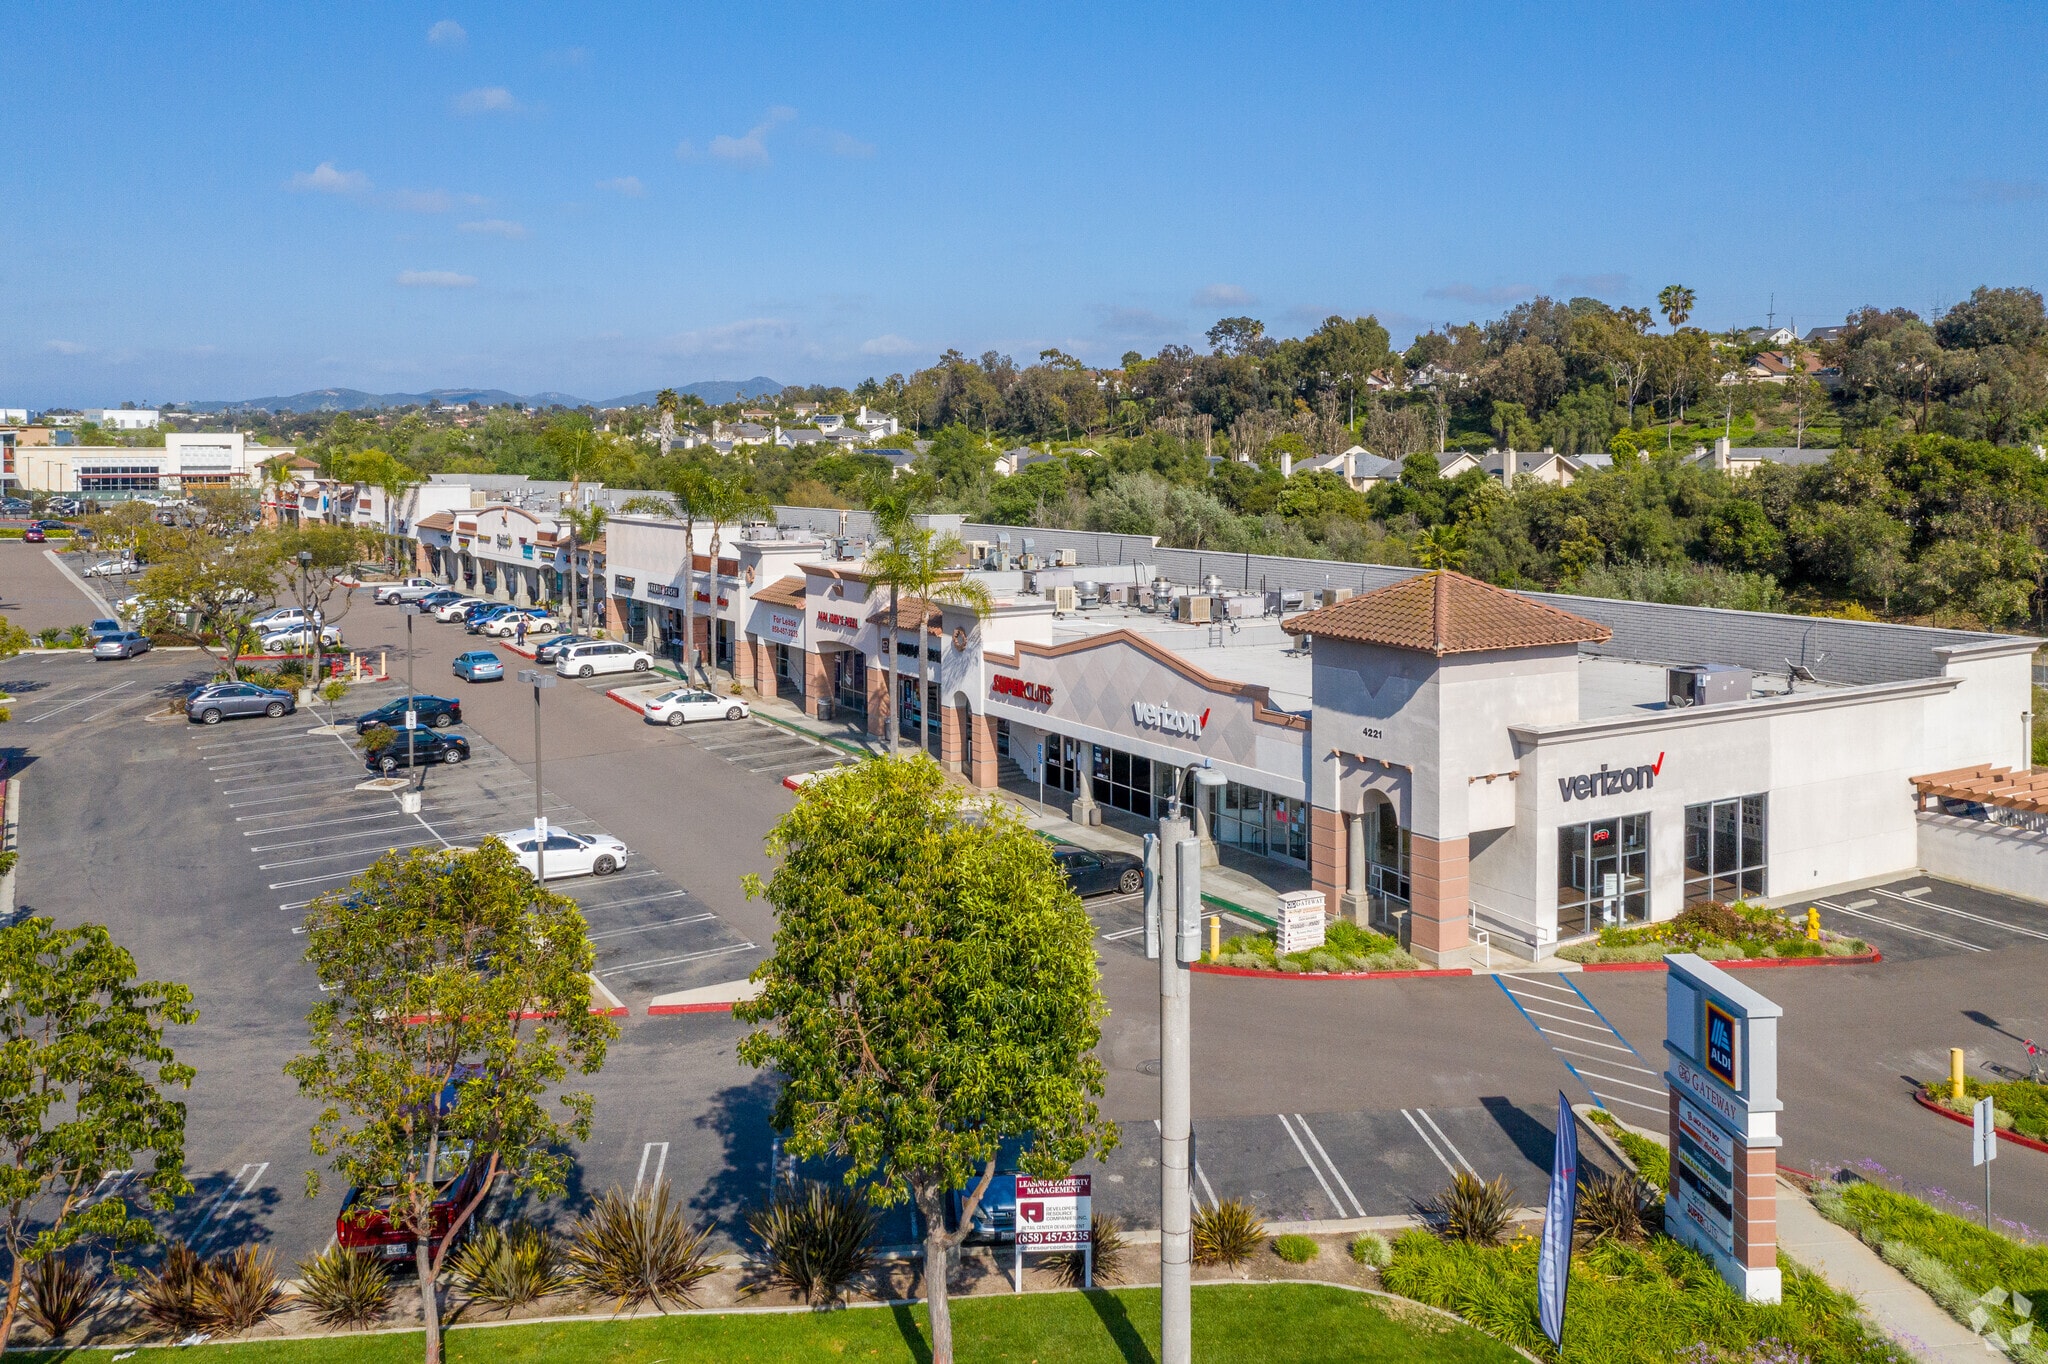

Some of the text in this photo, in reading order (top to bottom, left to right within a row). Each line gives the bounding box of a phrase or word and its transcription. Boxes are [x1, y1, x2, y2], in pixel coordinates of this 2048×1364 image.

[773, 614, 797, 627] For Lease
[992, 674, 1052, 705] SUPERCUTS
[1133, 700, 1202, 737] verizon
[1362, 727, 1382, 739] 4221
[1558, 763, 1653, 802] verizon
[1593, 831, 1609, 841] OPEN
[1296, 898, 1323, 907] GATEWAY
[1710, 1047, 1731, 1071] ALDI
[1692, 1073, 1737, 1120] GATEWAY
[1026, 1186, 1082, 1195] MANAGEMENT
[1687, 1202, 1719, 1239] SUPERCUTS
[1018, 1232, 1043, 1244] (858)
[1045, 1231, 1089, 1242] 457-3235
